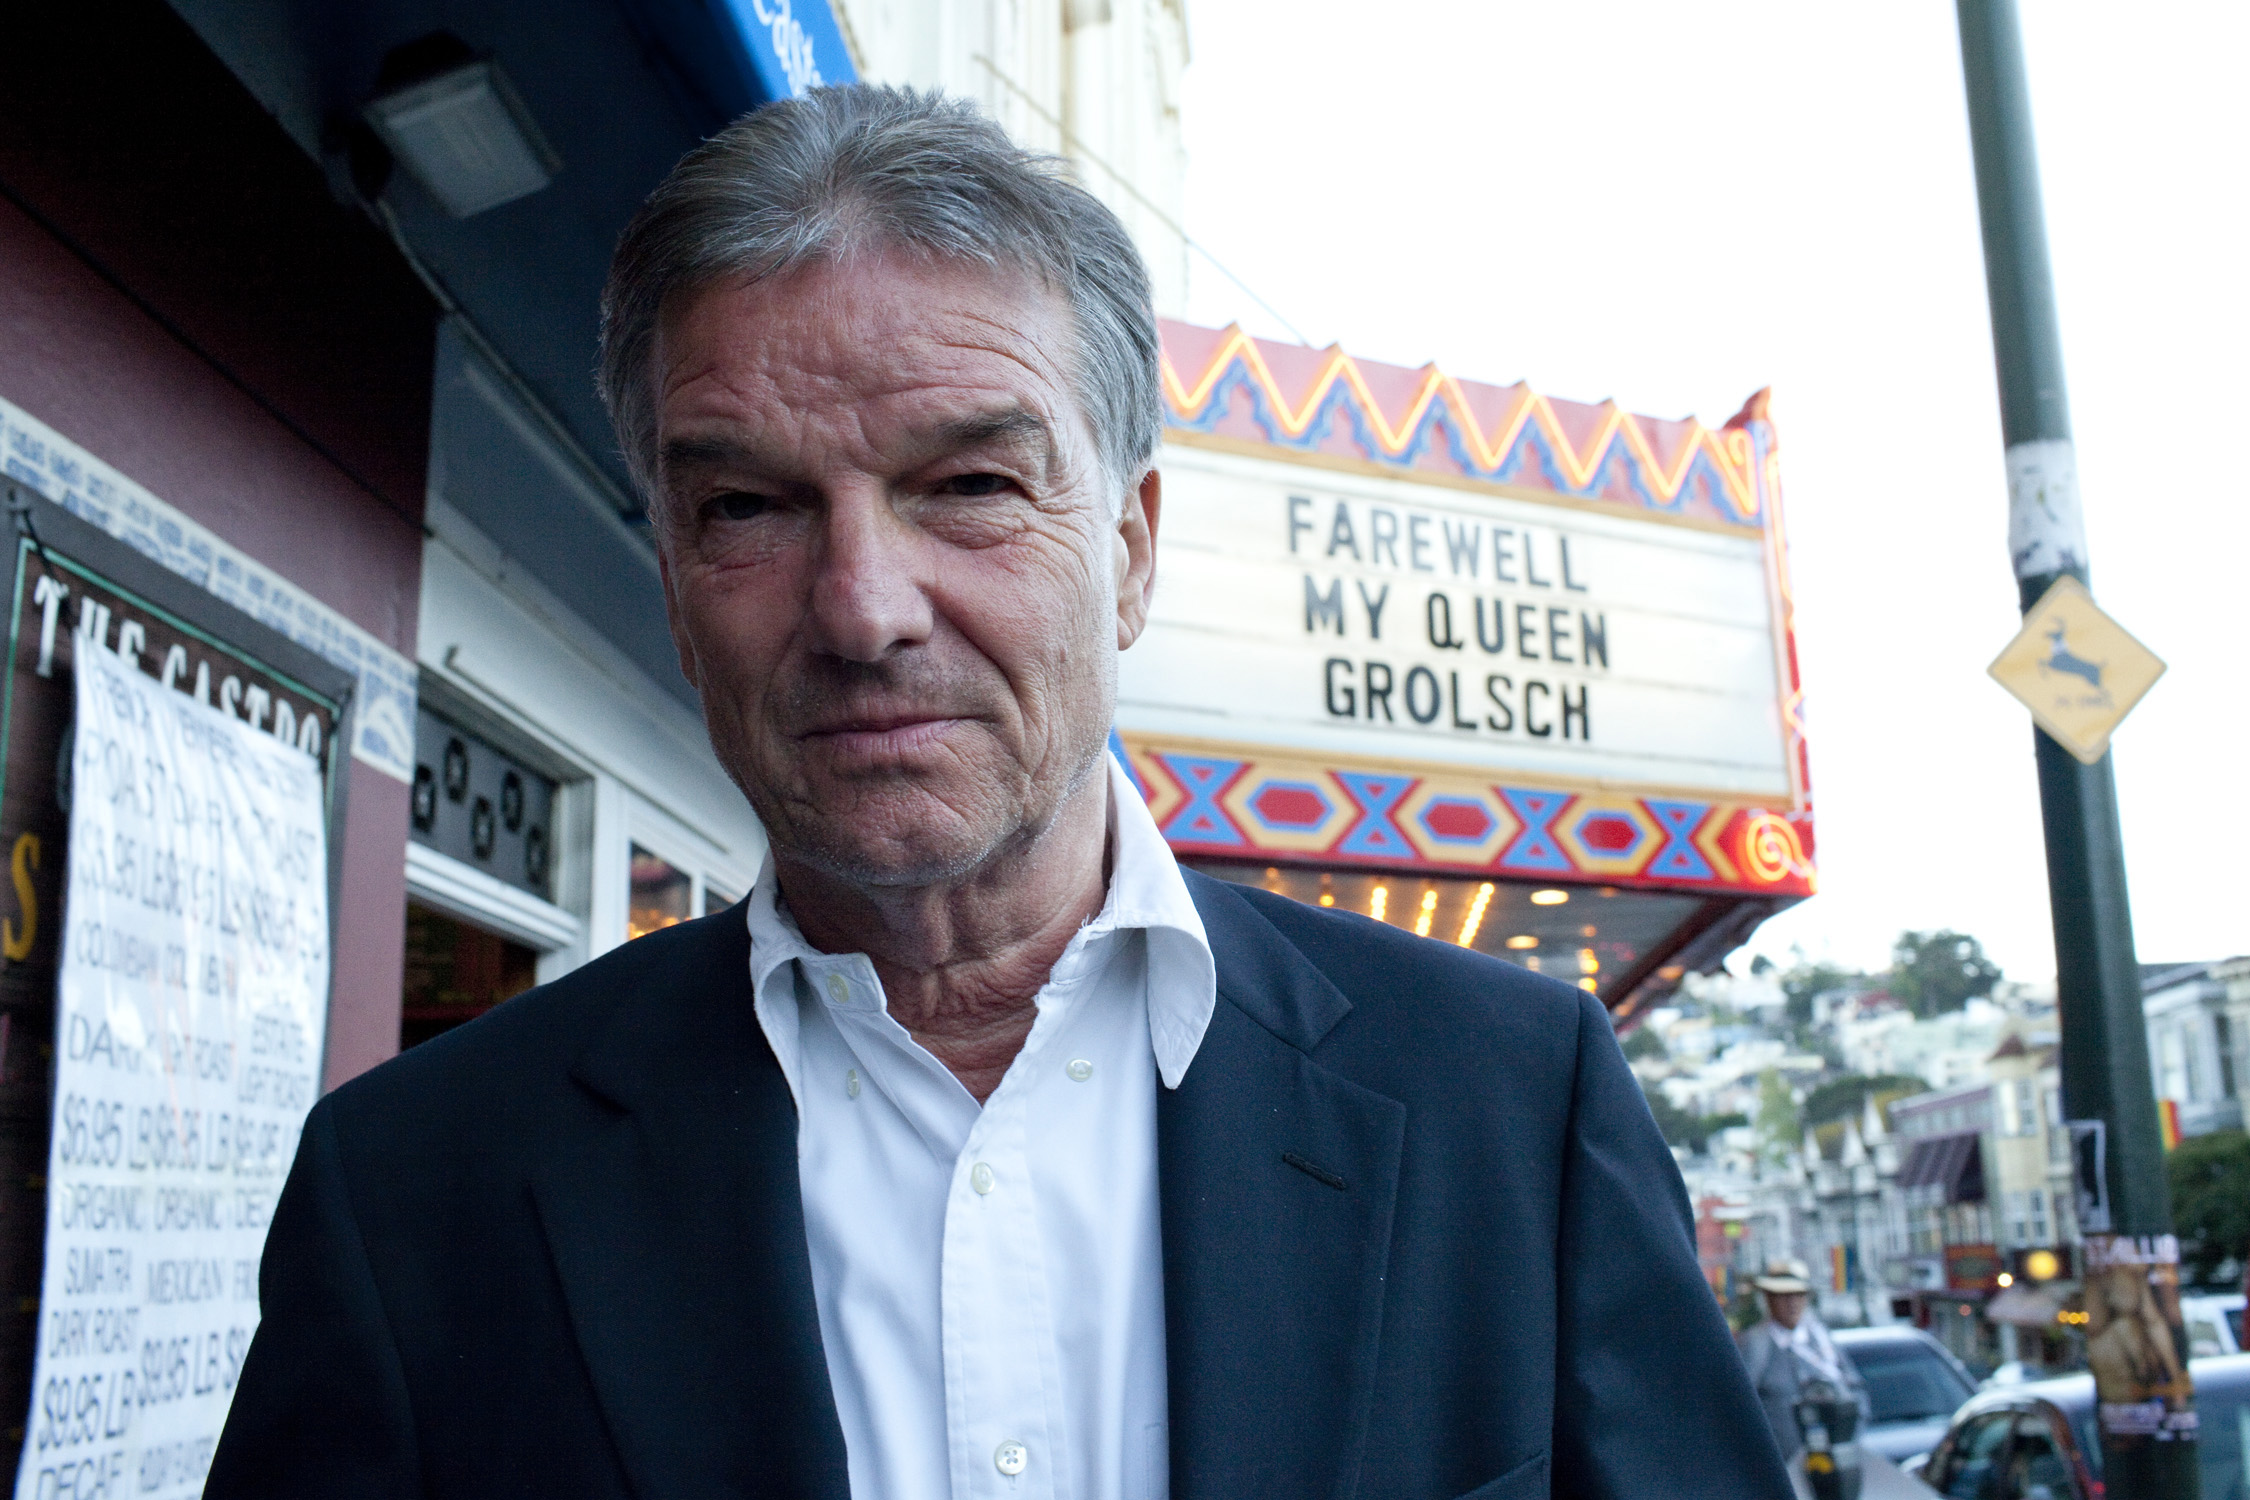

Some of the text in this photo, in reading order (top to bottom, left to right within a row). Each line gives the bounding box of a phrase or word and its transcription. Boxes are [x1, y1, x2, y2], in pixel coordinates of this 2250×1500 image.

[1286, 494, 1589, 593] FAREWELL
[1303, 573, 1610, 668] MY QUEEN
[1324, 657, 1591, 742] GROLSCH
